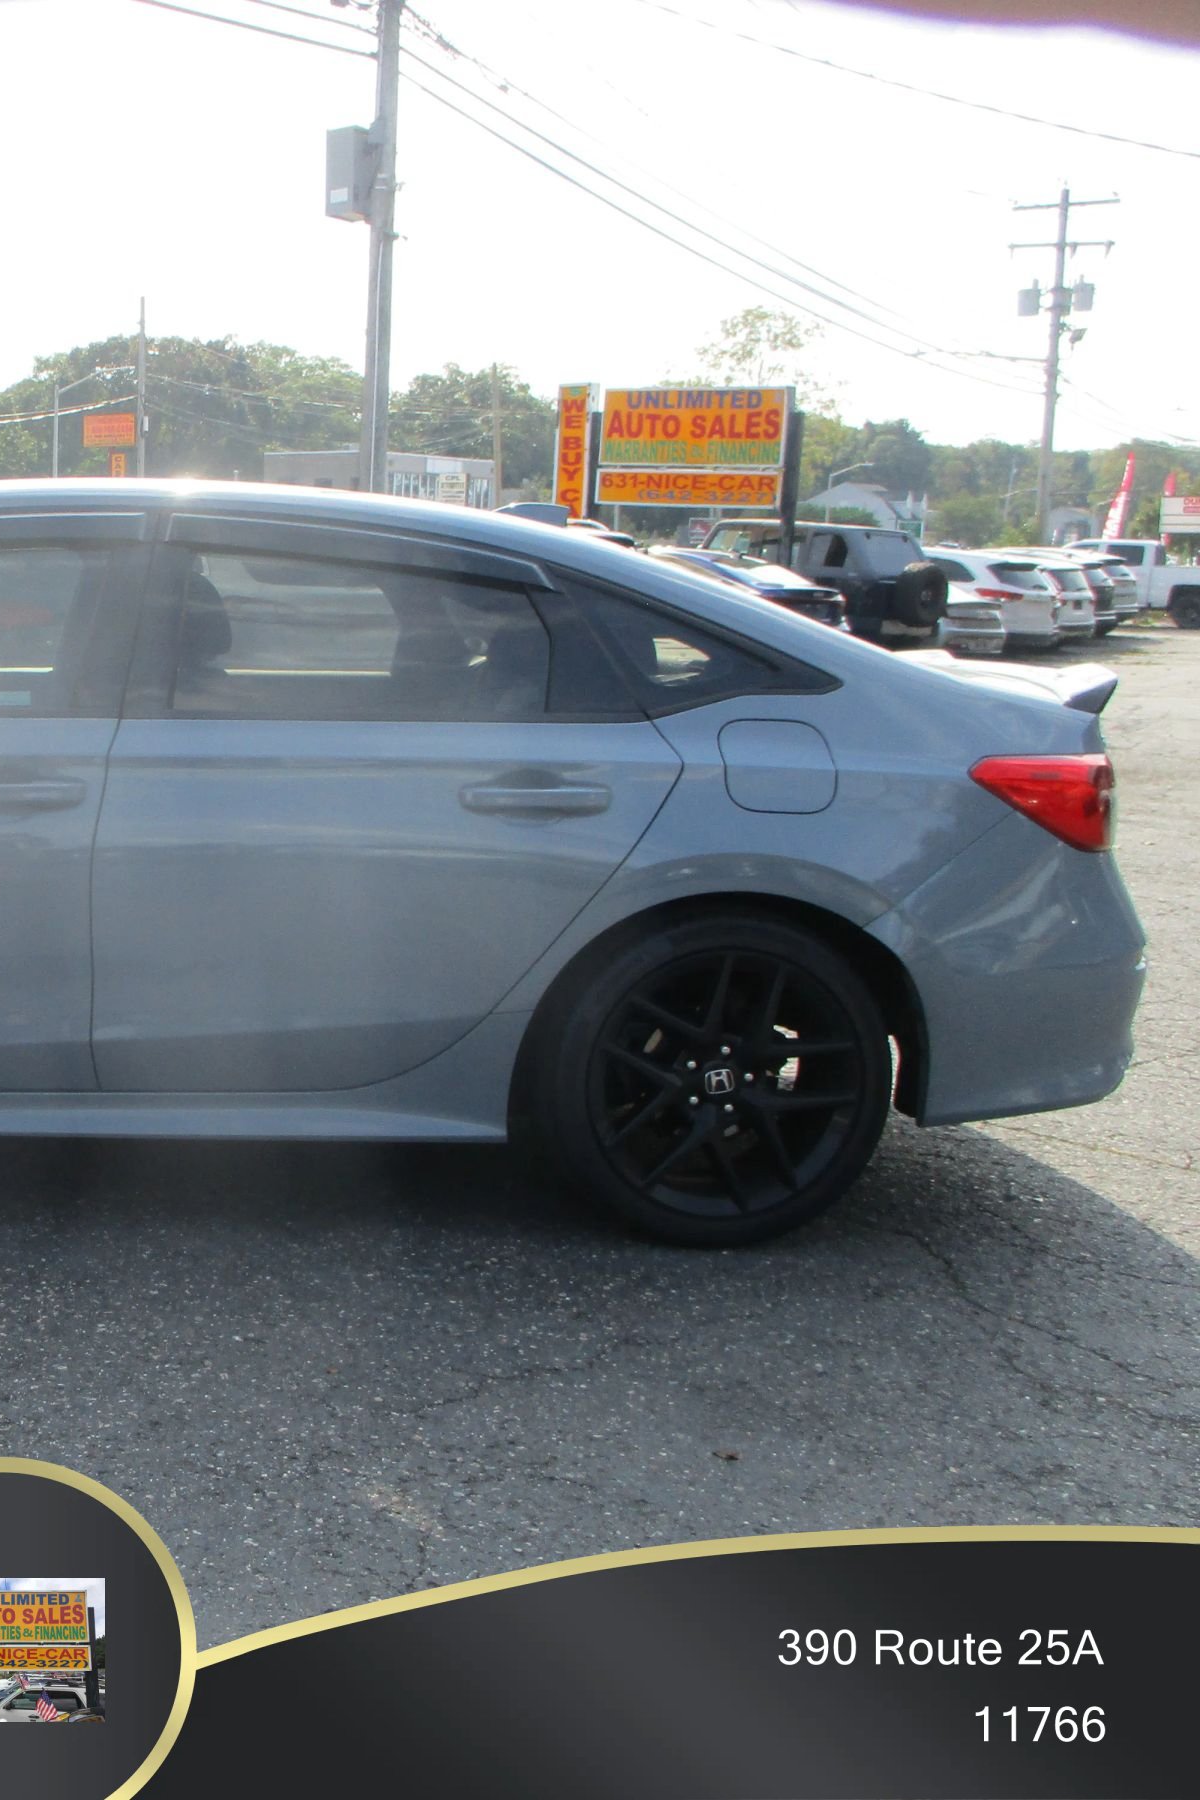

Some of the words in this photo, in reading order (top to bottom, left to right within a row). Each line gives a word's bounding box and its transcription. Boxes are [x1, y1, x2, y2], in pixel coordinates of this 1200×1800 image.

[627, 390, 762, 409] UNLIMITED
[562, 399, 585, 429] WE
[607, 410, 681, 438] AUTO
[689, 409, 780, 439] SALES
[560, 436, 582, 481] BUY
[604, 440, 688, 463] WARRANTIES
[706, 440, 781, 463] FINANCING
[601, 474, 776, 491] 631-NICE-CAR
[638, 489, 776, 502] (642-3227)
